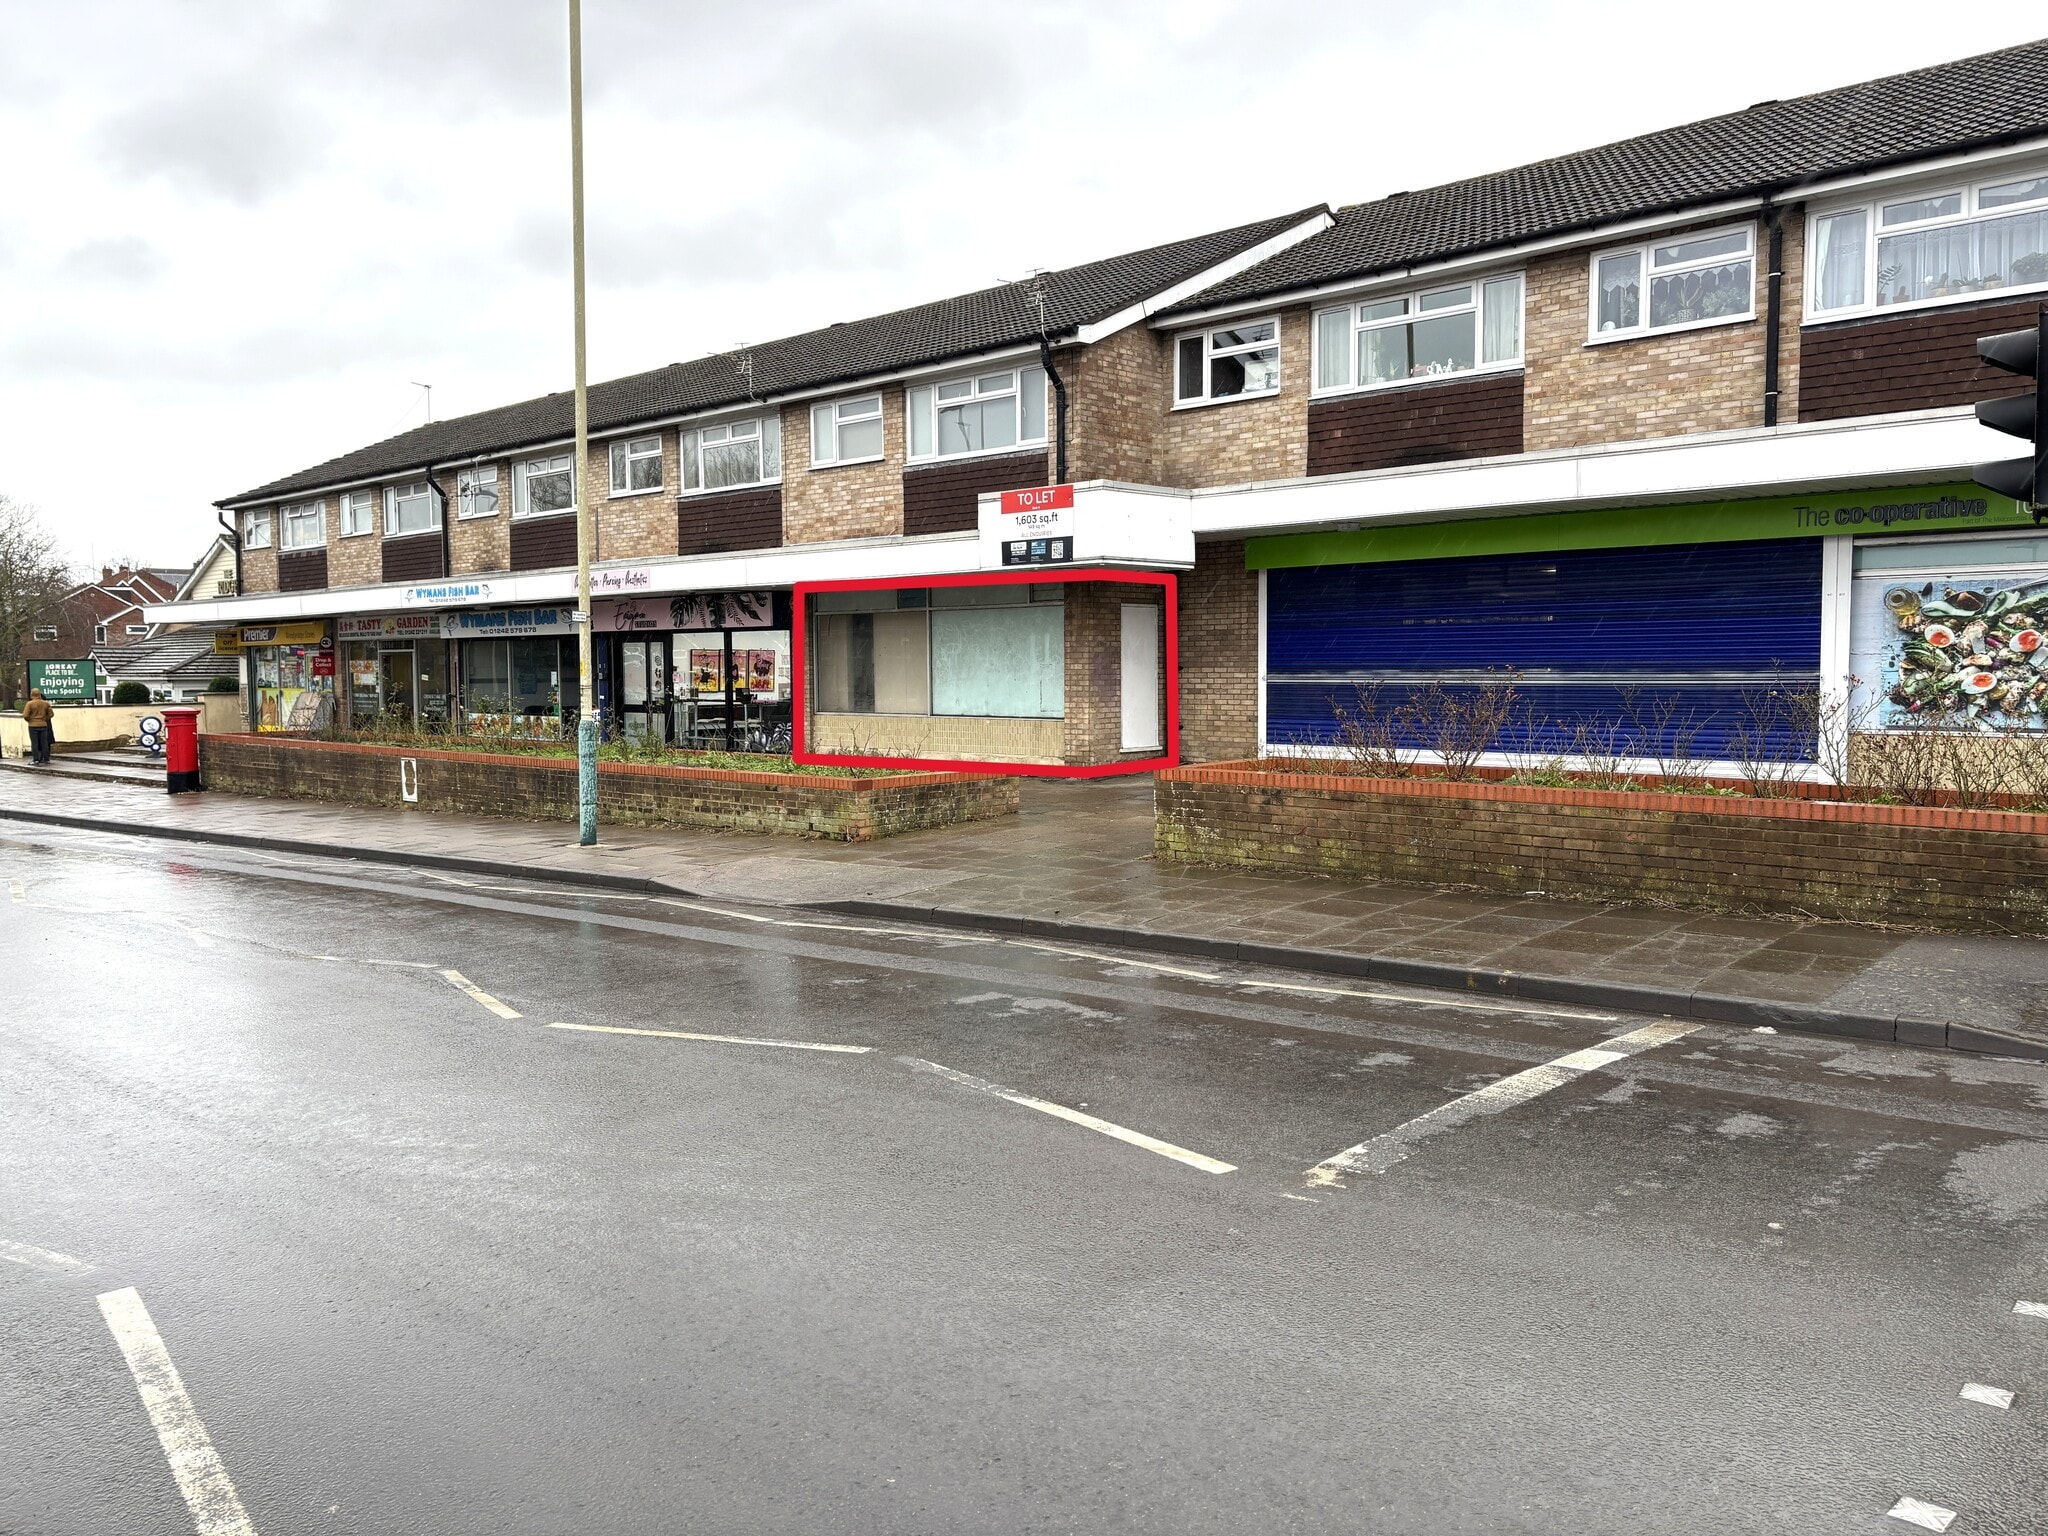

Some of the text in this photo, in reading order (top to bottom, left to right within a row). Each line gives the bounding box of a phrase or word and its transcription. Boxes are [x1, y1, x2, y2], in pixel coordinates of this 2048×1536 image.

[1017, 490, 1056, 506] TO LET
[1015, 514, 1037, 527] 1,603
[1793, 506, 1830, 528] The
[416, 585, 479, 598] WYMANS FISH BAR
[357, 619, 382, 631] TASTY
[397, 616, 428, 629] GARDEN
[460, 611, 506, 628] WYMANS
[507, 609, 533, 626] FISH
[533, 608, 557, 625] BAR
[243, 627, 270, 641] Premier
[40, 677, 85, 687] Enjoying
